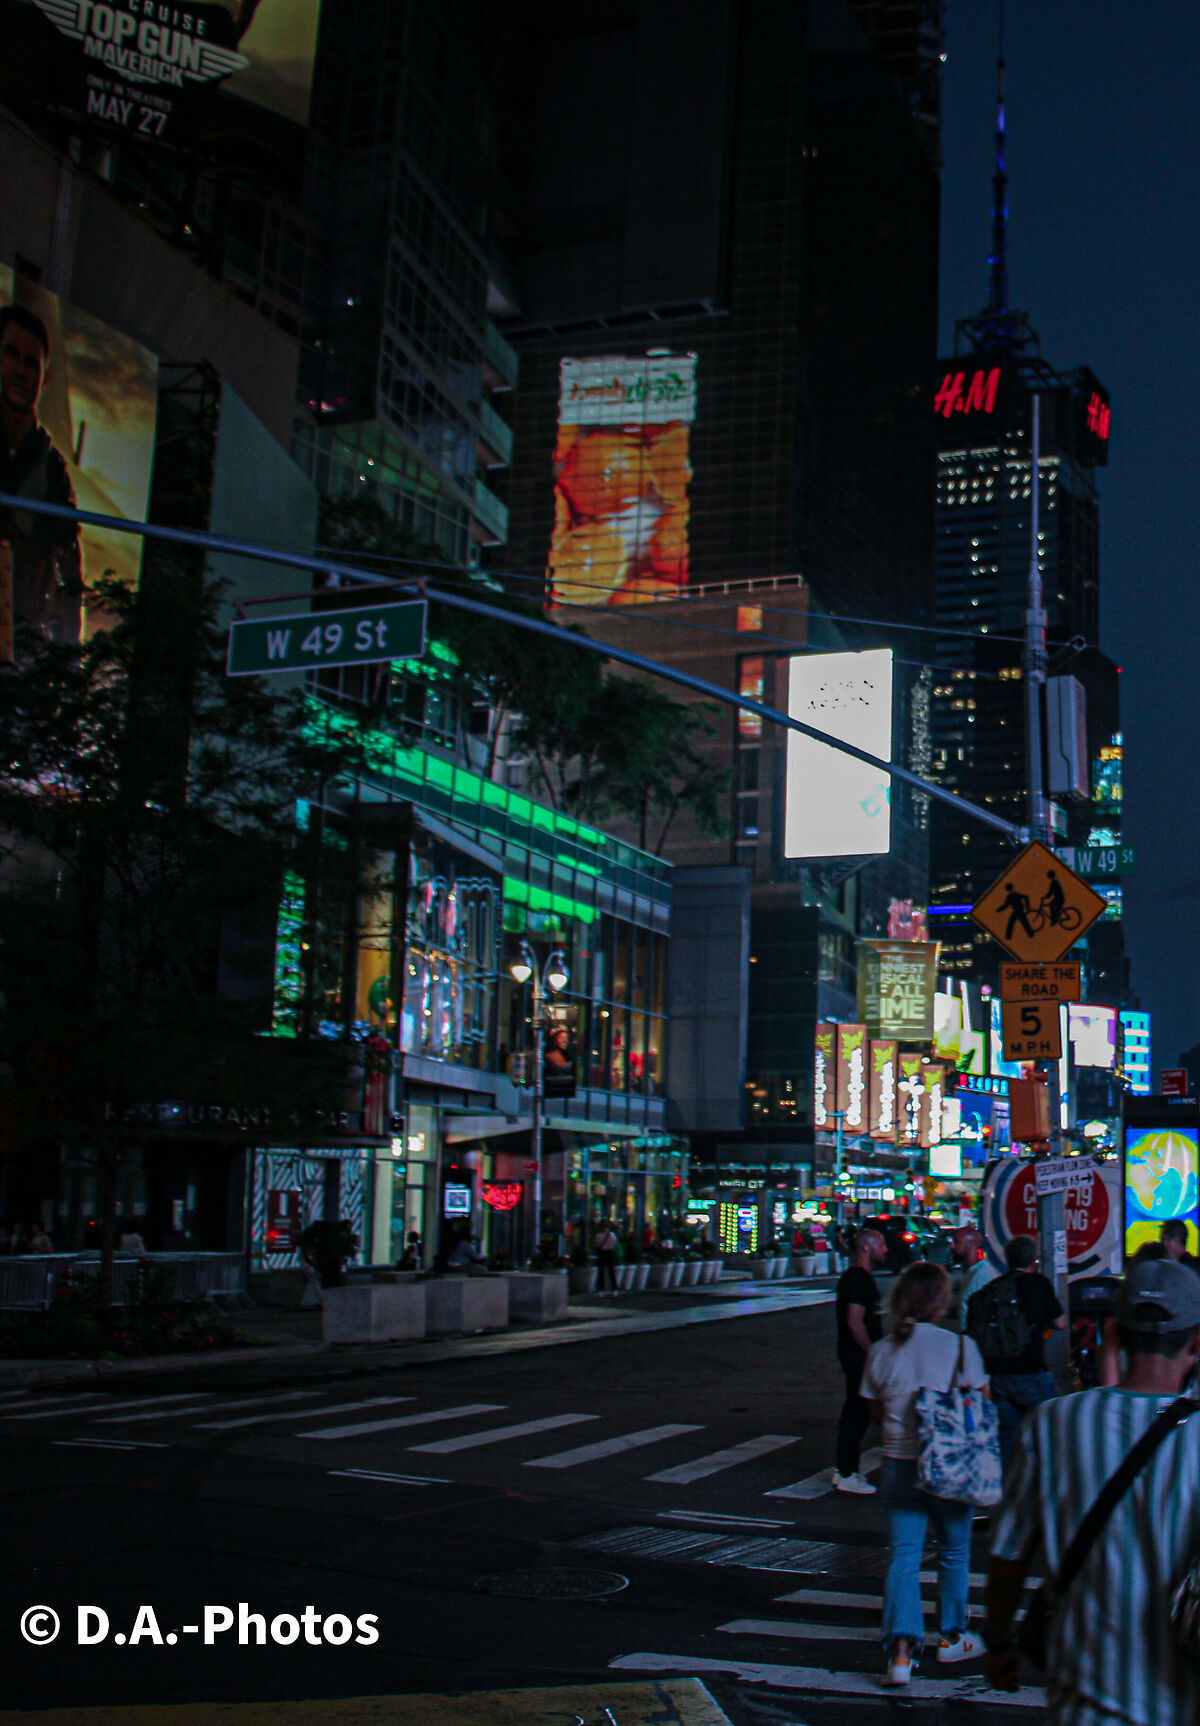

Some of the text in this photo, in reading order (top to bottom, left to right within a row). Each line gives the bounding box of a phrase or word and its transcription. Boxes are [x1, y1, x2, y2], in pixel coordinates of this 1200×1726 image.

[128, 0, 208, 36] CRUISE
[75, 0, 202, 73] TOP GUN
[83, 36, 185, 88] MAVERICK
[87, 88, 168, 137] MAY 27
[266, 619, 389, 660] W 49 St
[1078, 848, 1134, 873] W 49 St
[1005, 967, 1076, 980] SHARE THE
[1021, 984, 1059, 996] ROAD
[1021, 1006, 1042, 1036] 5
